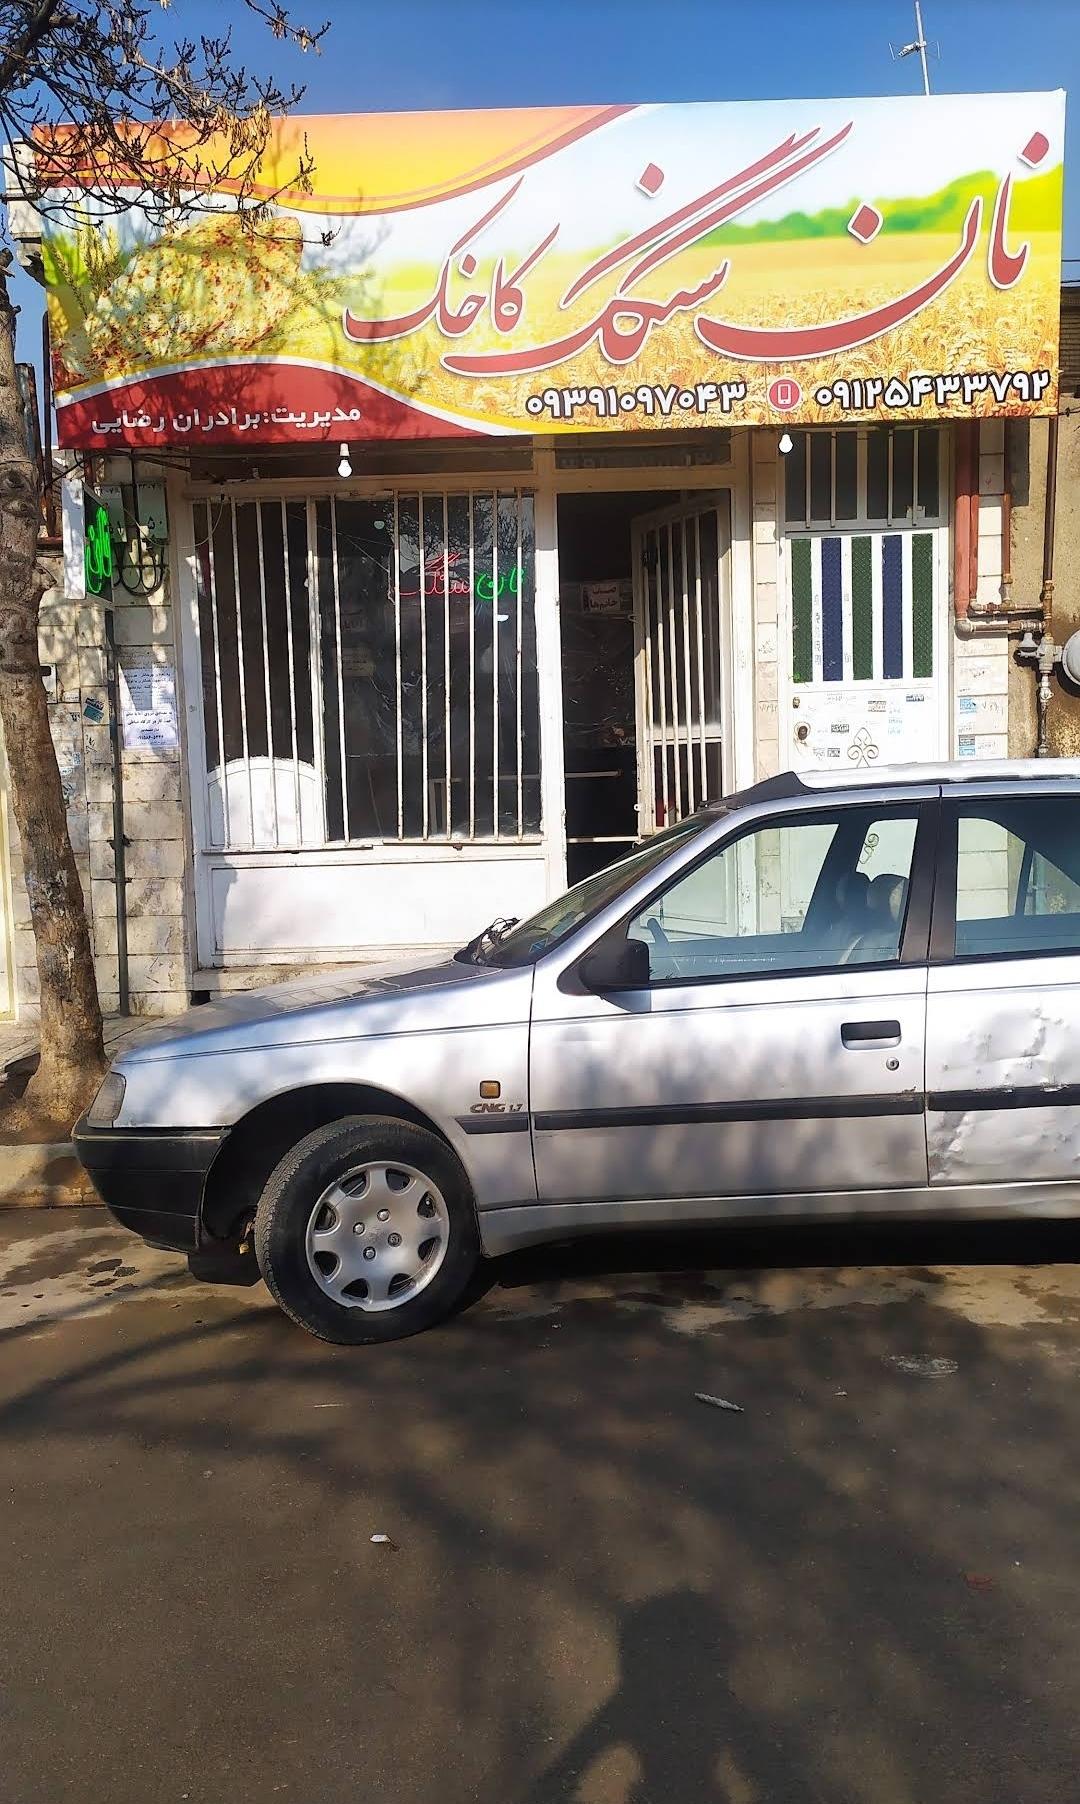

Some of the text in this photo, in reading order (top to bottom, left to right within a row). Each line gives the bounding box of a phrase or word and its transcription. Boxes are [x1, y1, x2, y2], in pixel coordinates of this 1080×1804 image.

[342, 121, 1050, 377] نان سنگک کاخک
[526, 381, 747, 418] ۰۹۳۹۱۰۹۷۰۴۳
[815, 370, 1051, 411] ۰۹۱۲۵۴۳۳۷۹۲
[91, 408, 165, 434] رضایی
[469, 1103, 523, 1114] CNG 1.7
